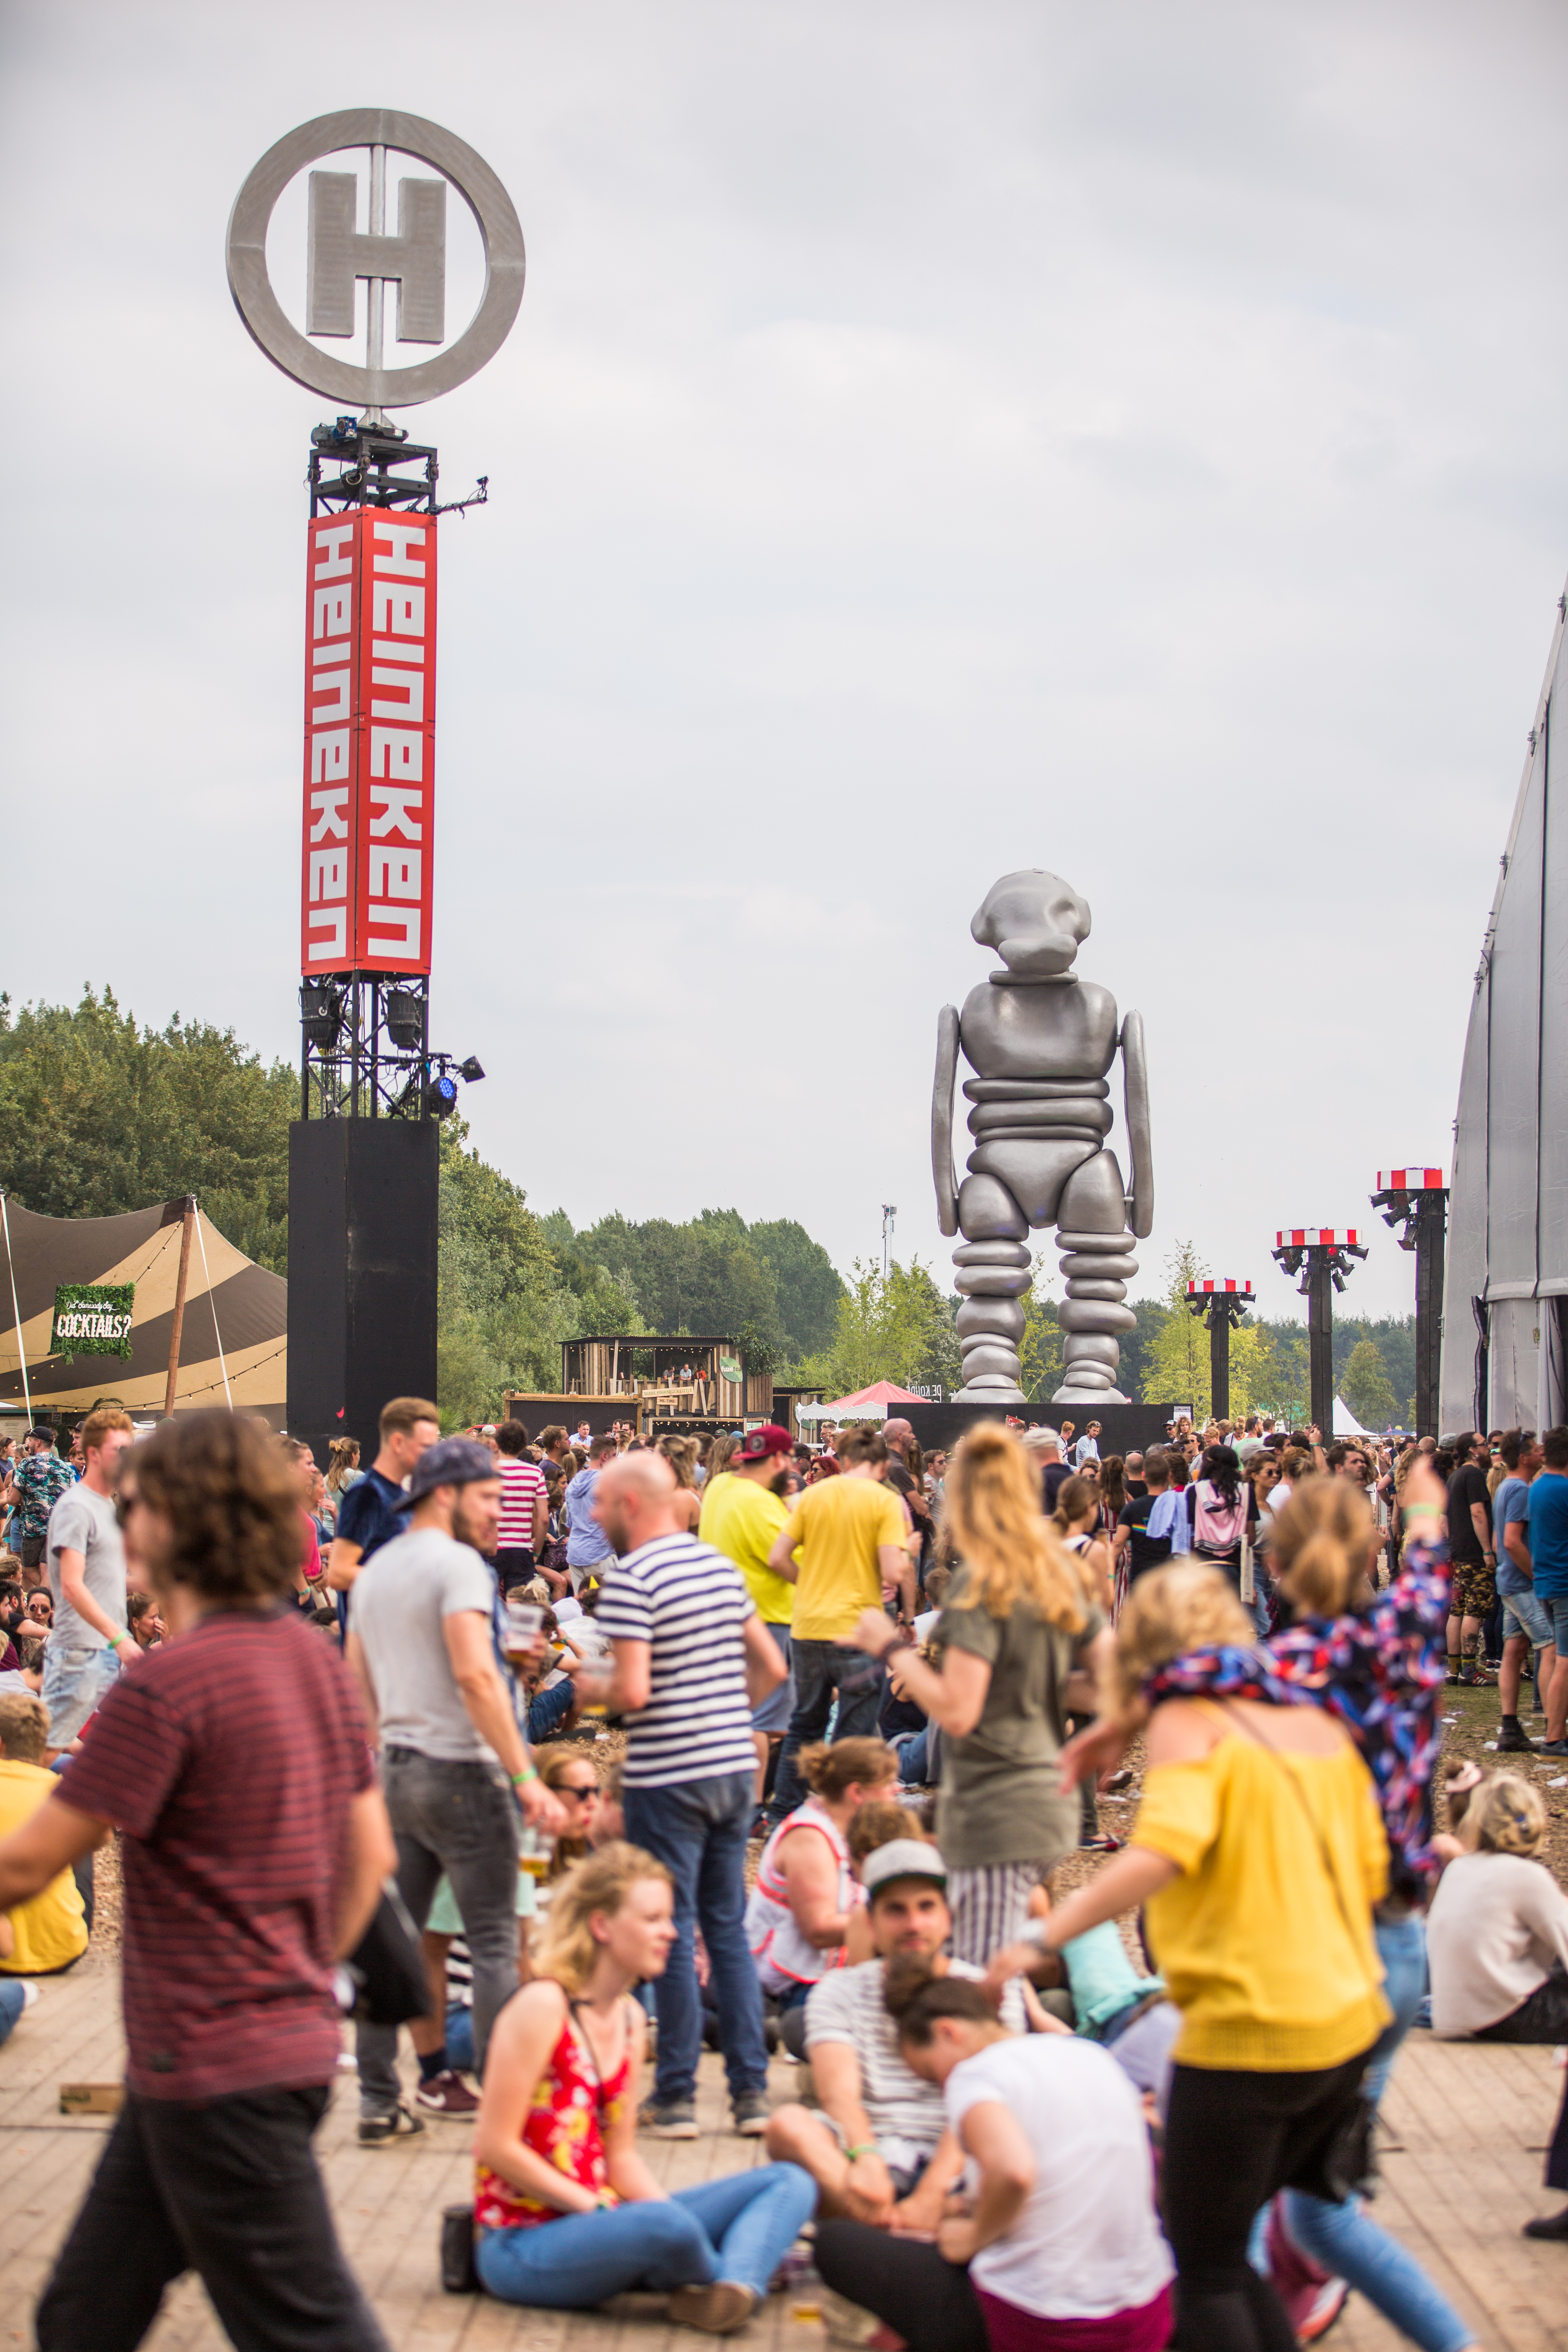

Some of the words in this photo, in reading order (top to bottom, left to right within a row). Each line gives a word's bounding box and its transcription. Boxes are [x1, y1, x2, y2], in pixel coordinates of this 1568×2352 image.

[306, 170, 446, 344] H
[309, 524, 354, 961] Heineken
[368, 521, 425, 959] Heineken
[57, 1314, 132, 1338] COCKTAILS?
